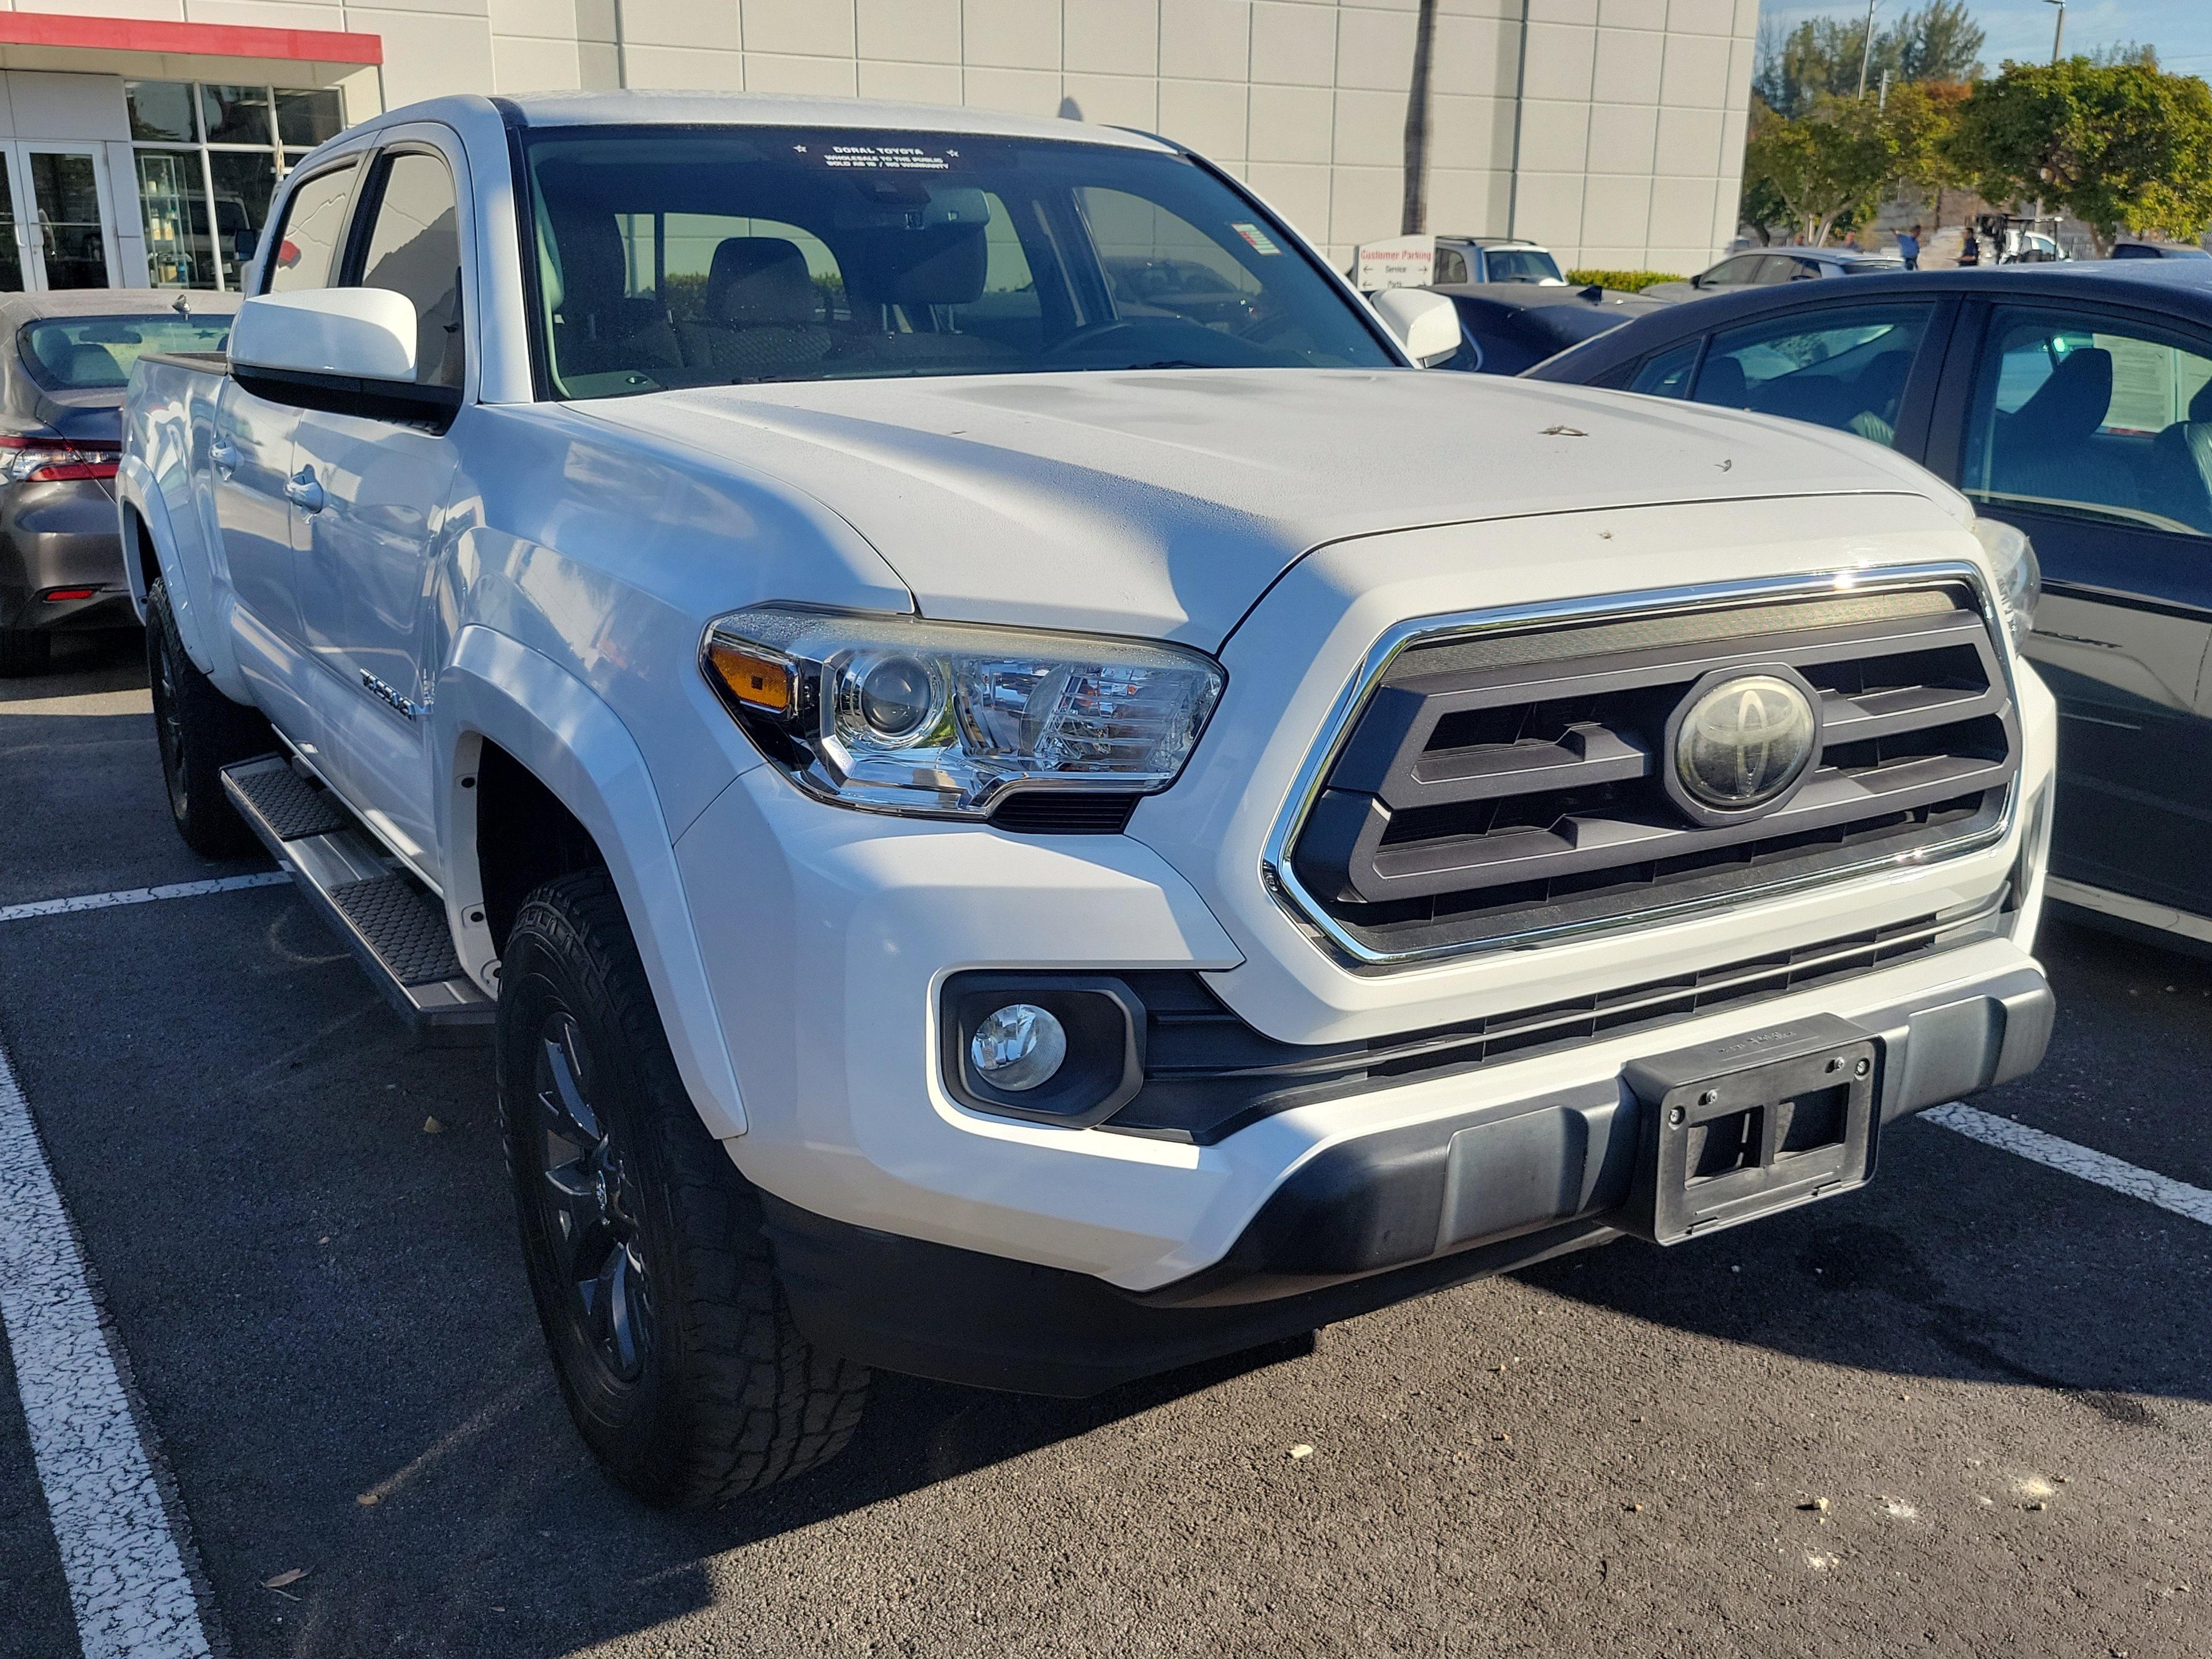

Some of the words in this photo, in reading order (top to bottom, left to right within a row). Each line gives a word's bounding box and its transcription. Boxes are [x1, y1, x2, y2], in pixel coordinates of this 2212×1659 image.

[832, 146, 876, 154] DORAL
[876, 147, 924, 156] TOYOTA
[1361, 250, 1398, 260] Customer
[1401, 251, 1431, 262] Parking
